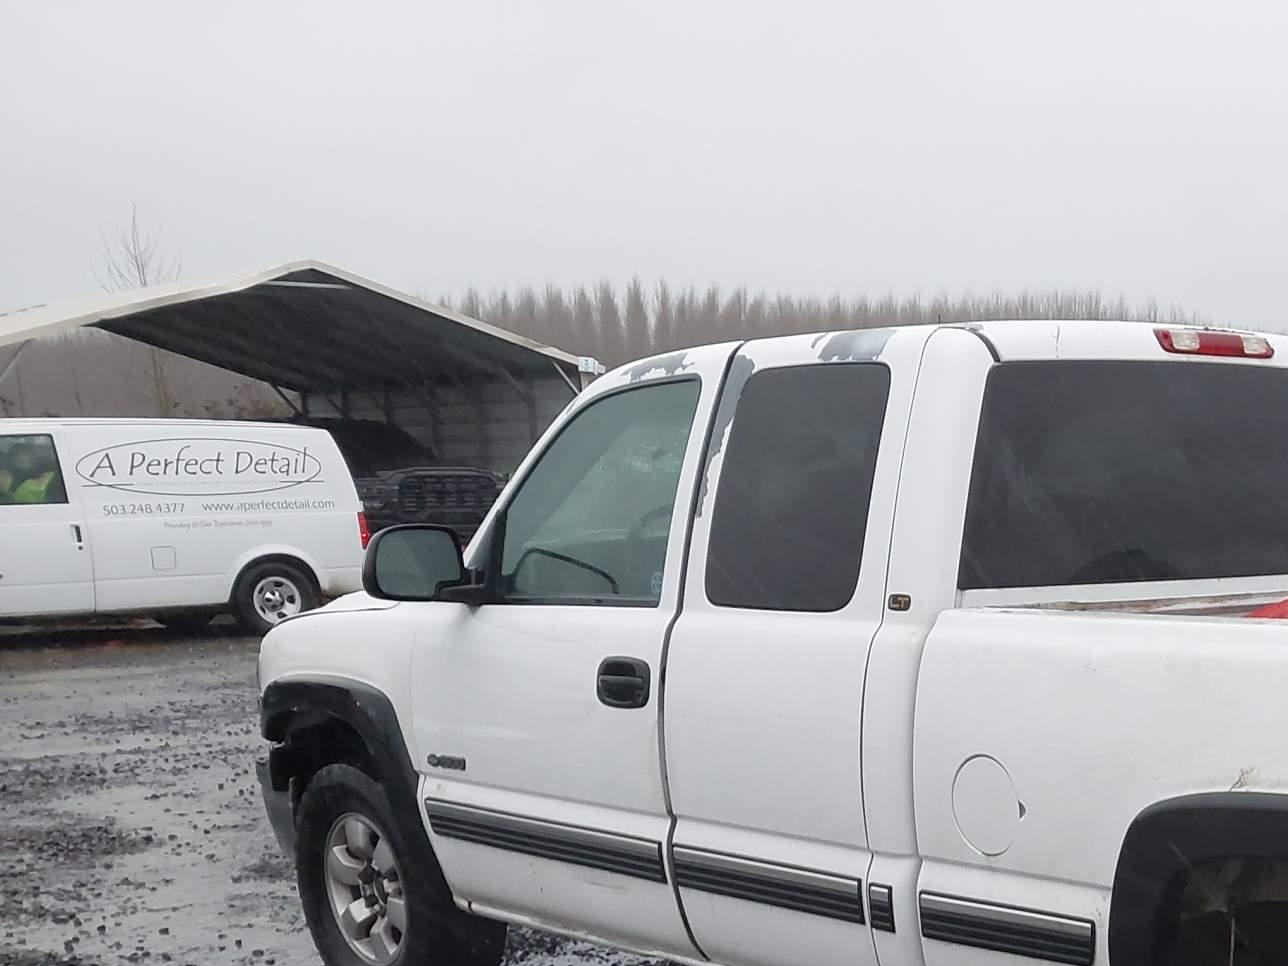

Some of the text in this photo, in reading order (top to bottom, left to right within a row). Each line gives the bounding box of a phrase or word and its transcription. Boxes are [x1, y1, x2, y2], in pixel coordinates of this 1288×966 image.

[89, 445, 308, 478] A Perfect Detail
[102, 500, 335, 516] 503.248.4377 www.aperfectdetail.com
